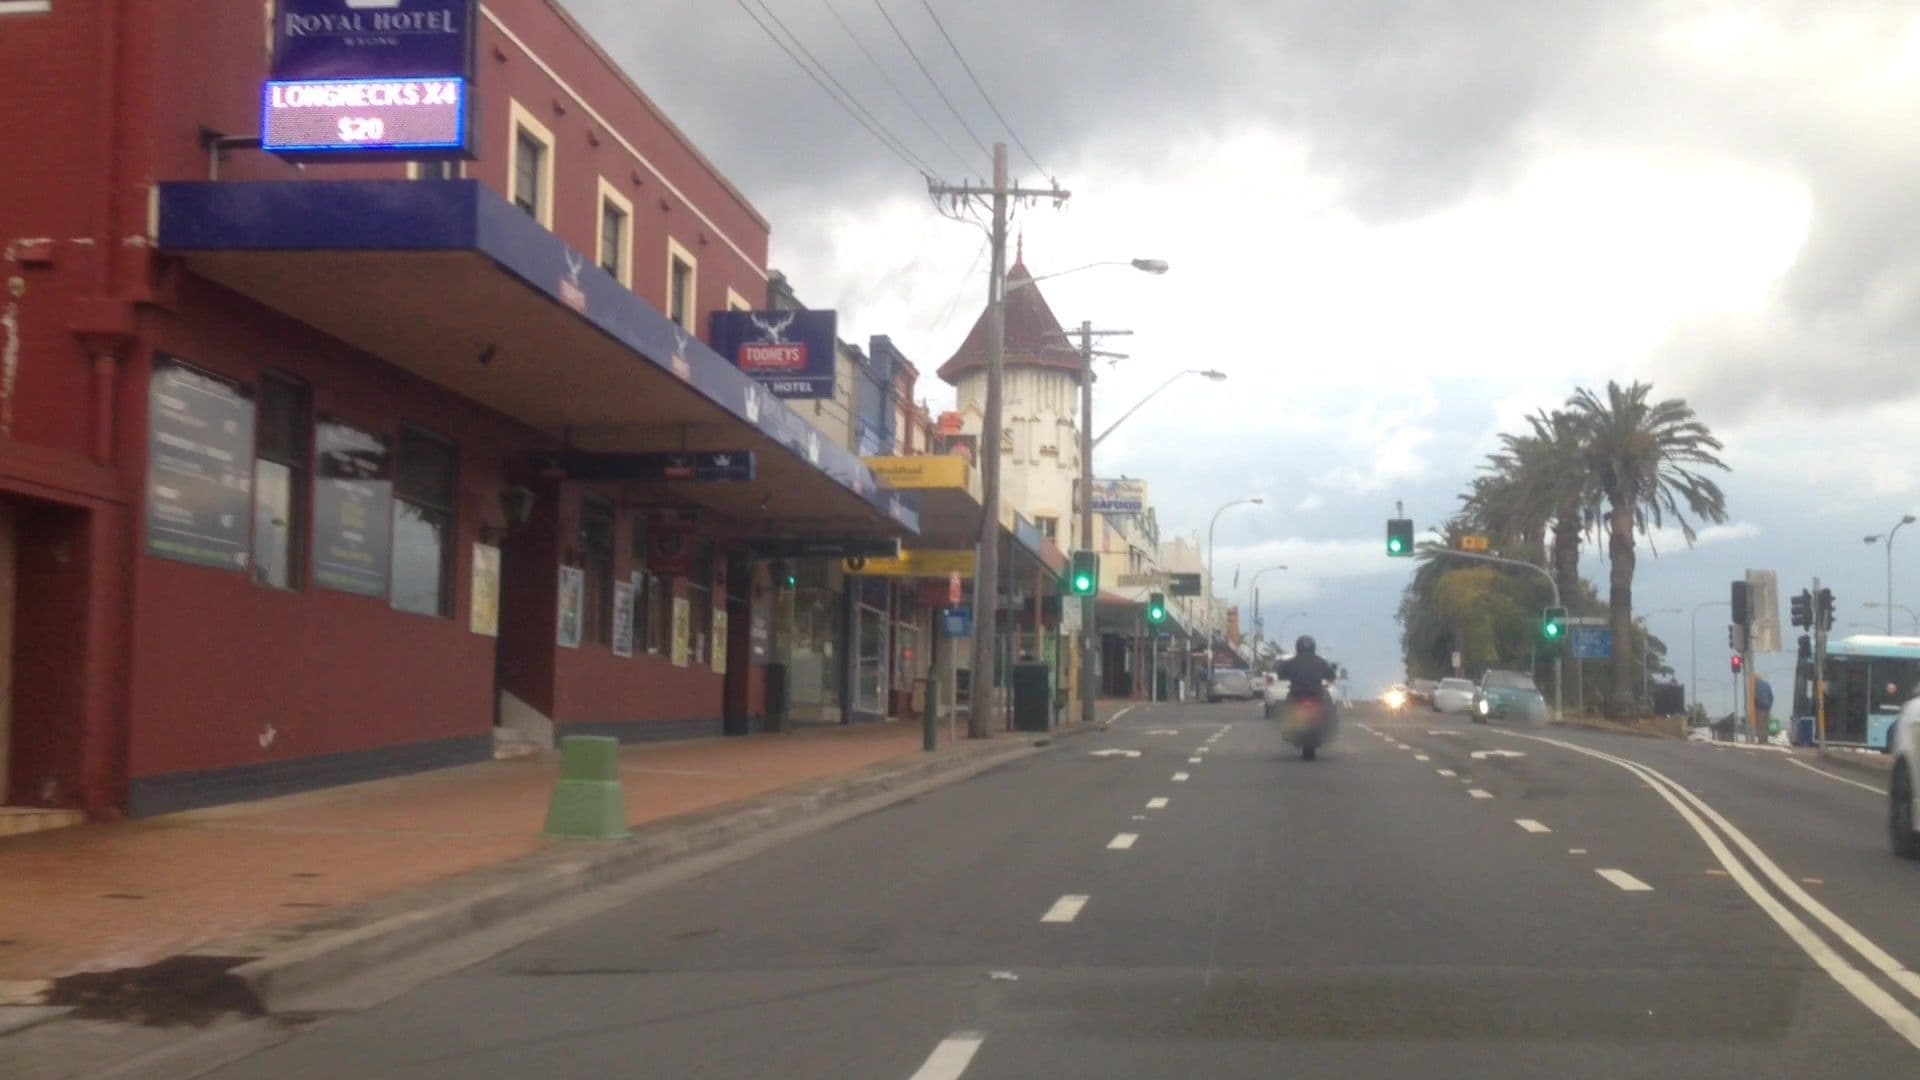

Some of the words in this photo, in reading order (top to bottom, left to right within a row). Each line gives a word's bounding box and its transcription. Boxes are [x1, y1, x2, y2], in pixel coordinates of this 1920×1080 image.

[286, 13, 361, 36] ROYAL
[374, 9, 458, 33] HOTEL
[271, 83, 421, 108] LONGNECKS
[424, 81, 458, 105] X4
[337, 116, 384, 141] $20
[773, 381, 814, 393] HOTEL
